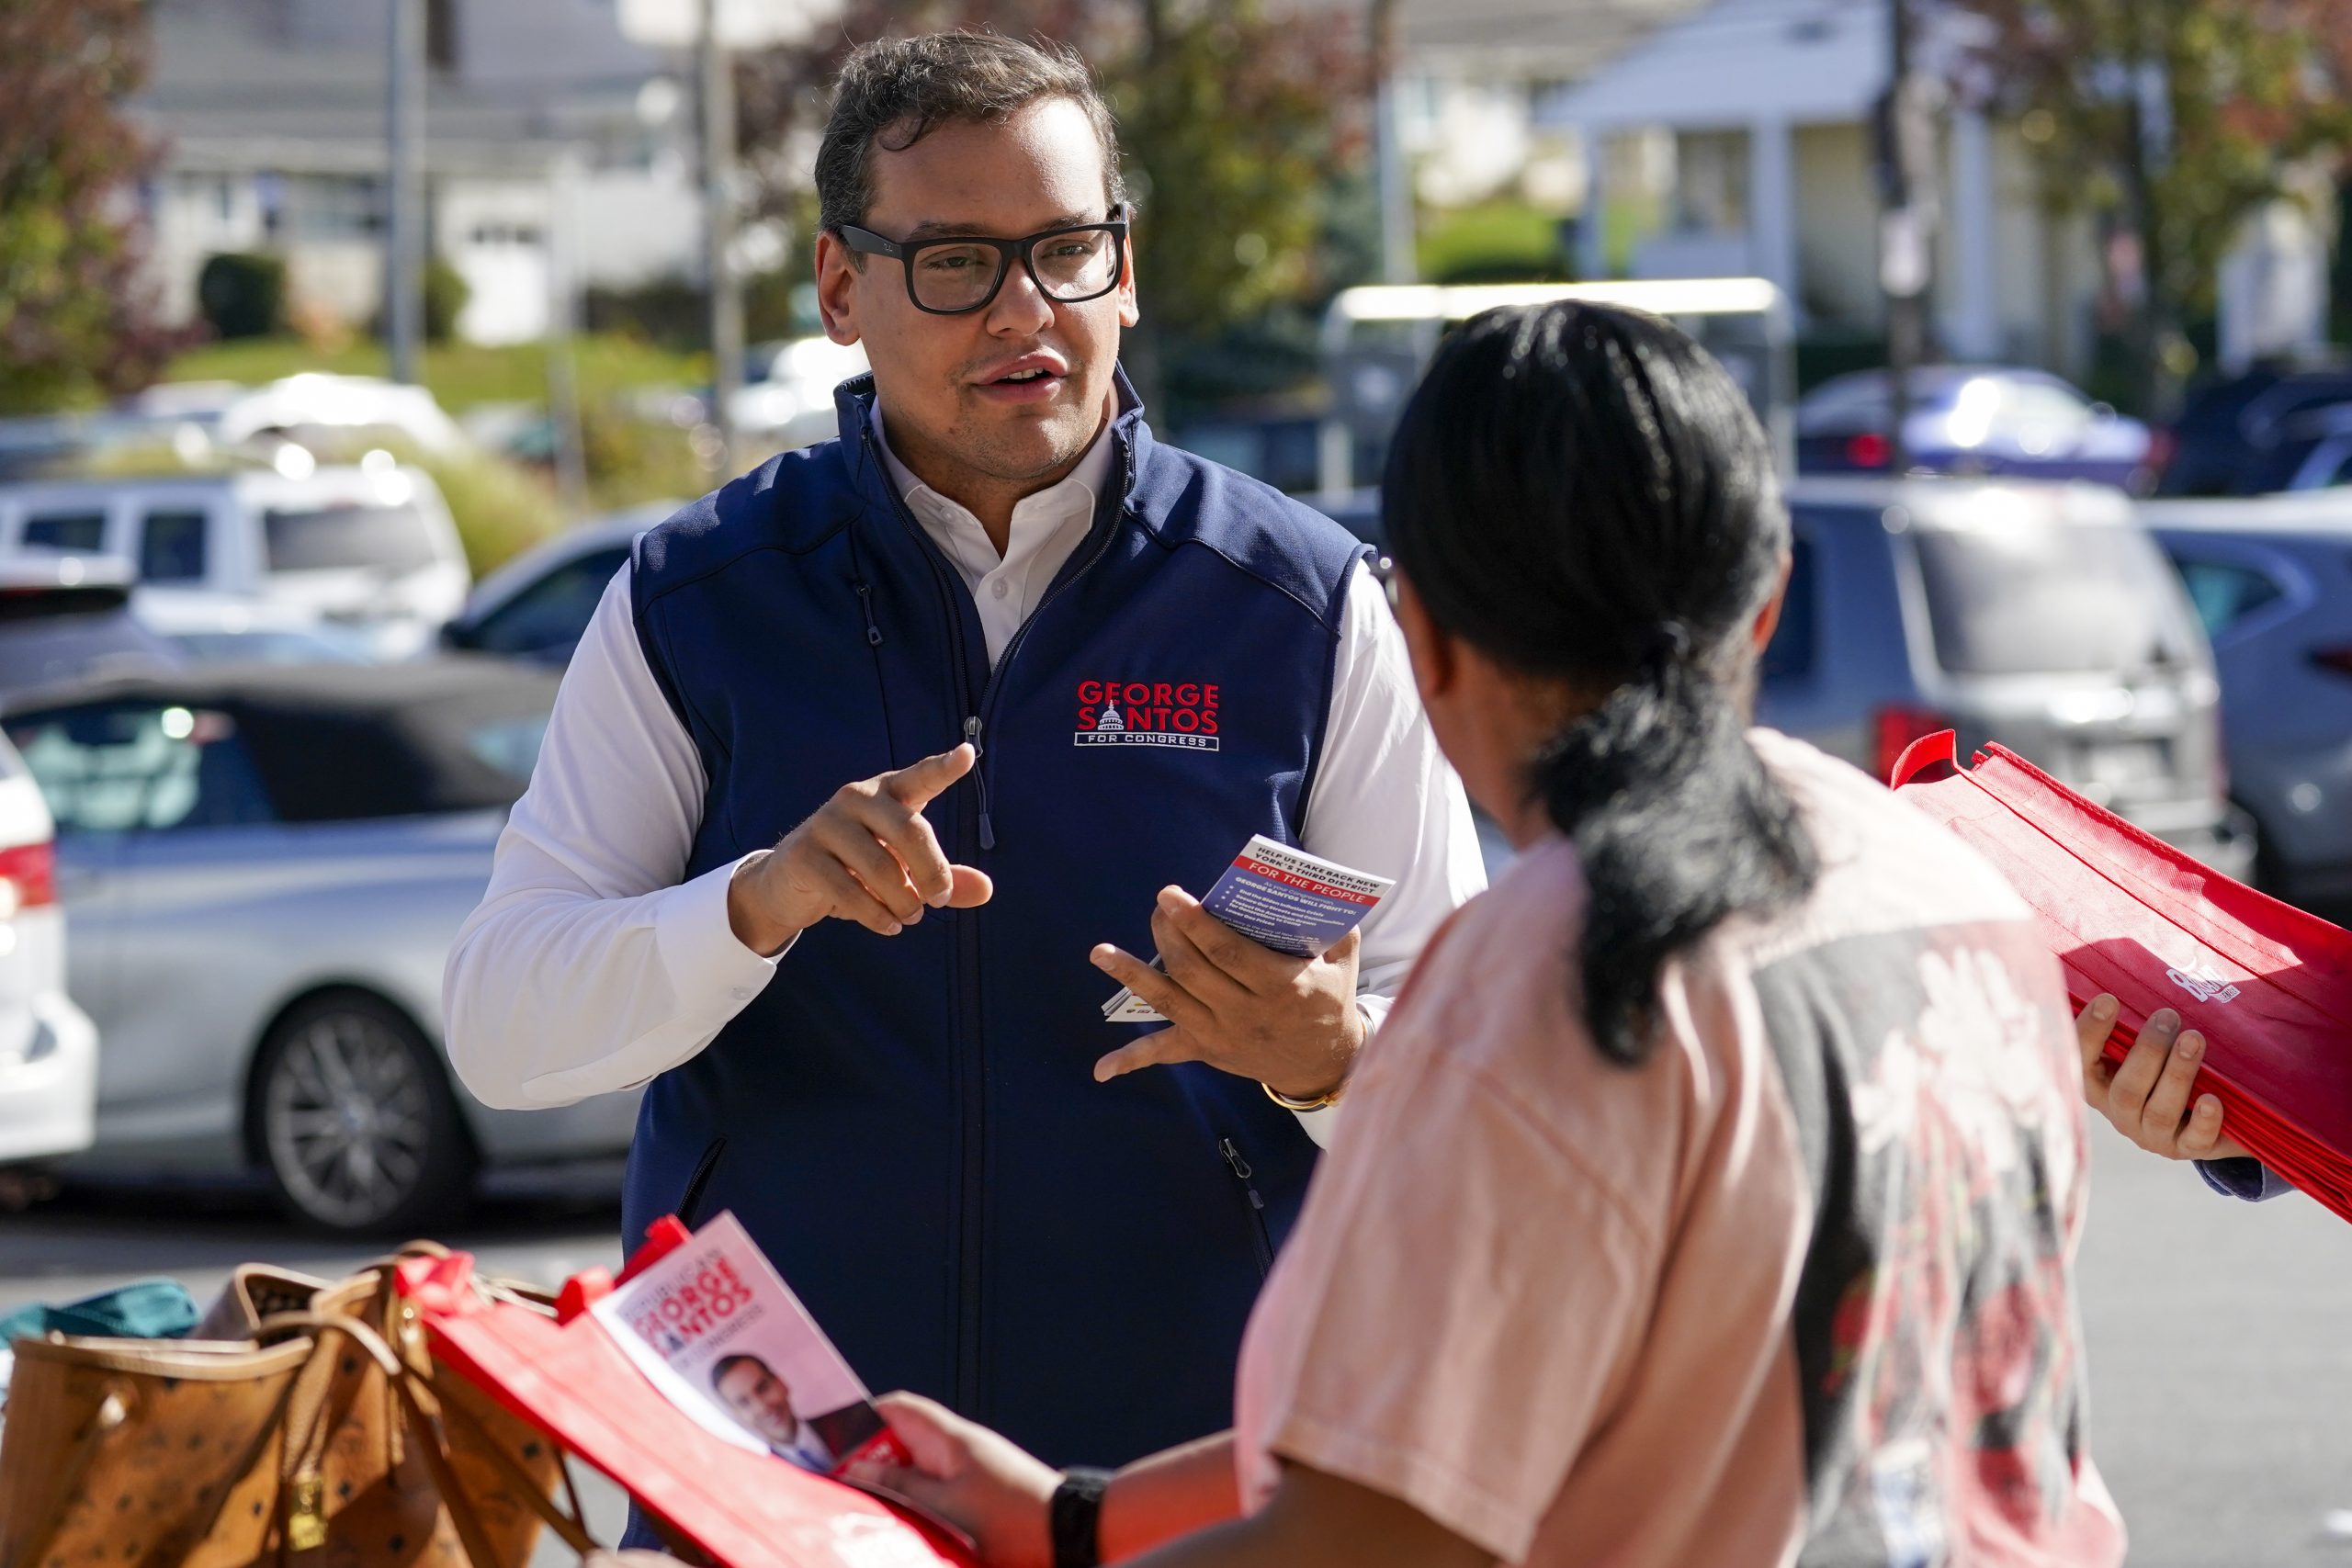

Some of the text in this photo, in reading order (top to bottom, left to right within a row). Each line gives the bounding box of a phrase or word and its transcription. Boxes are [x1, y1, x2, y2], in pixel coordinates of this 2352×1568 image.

[1077, 680, 1219, 709] GEORGE
[1088, 734, 1206, 748] FOR CONGRESS
[1250, 862, 1366, 903] FOR THE PEOPLE
[1255, 852, 1374, 894] YORK'S THIRD DISTRICT
[1258, 847, 1380, 888] HELP US TAKE BACK NEW
[1235, 876, 1268, 892] GEORGE
[1266, 887, 1300, 902] SANTOS
[1300, 897, 1318, 908] WILL
[1318, 902, 1343, 913] FIGHT
[631, 1257, 739, 1335] GEORGE
